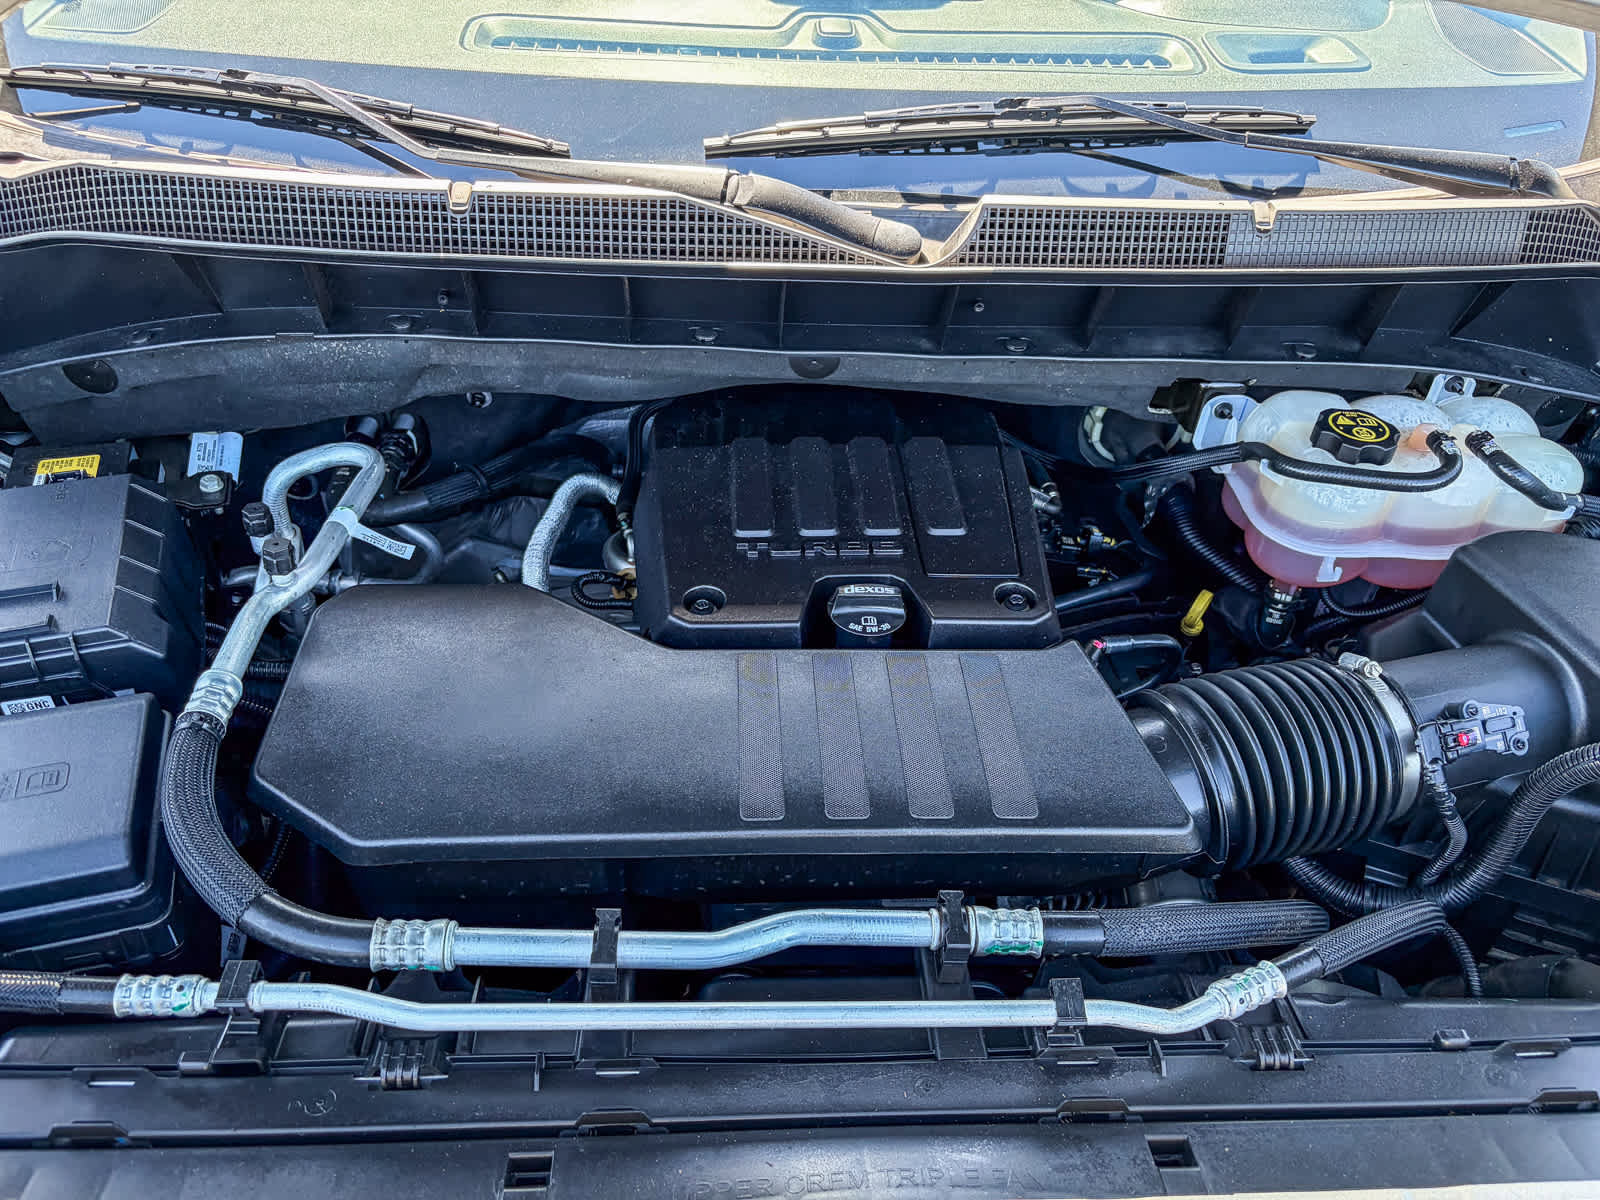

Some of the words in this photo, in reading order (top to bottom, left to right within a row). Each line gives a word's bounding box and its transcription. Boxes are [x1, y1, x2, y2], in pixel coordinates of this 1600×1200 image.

[844, 584, 896, 594] dexos
[848, 622, 864, 632] SAE
[26, 700, 50, 711] GNC
